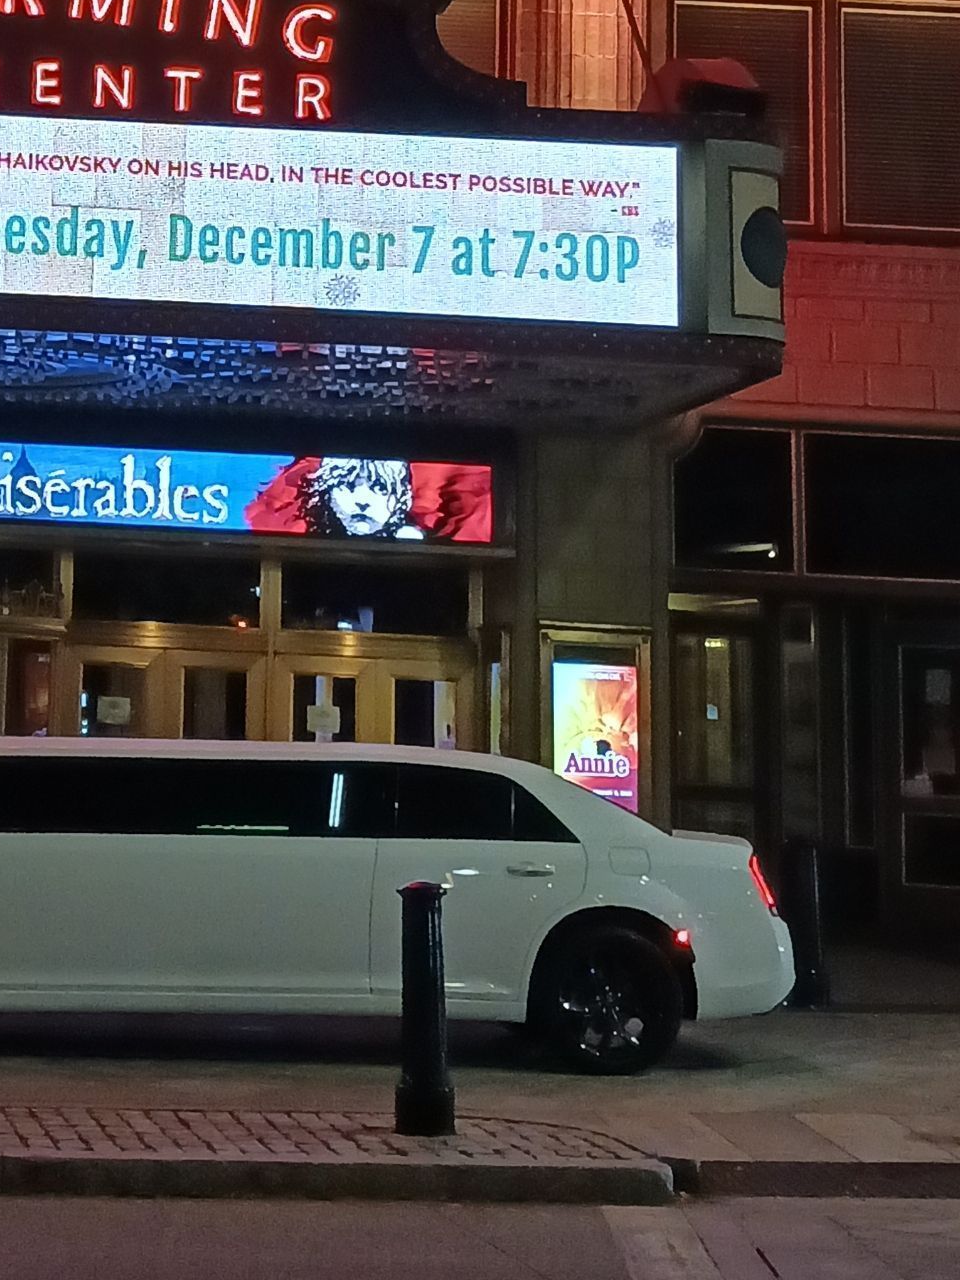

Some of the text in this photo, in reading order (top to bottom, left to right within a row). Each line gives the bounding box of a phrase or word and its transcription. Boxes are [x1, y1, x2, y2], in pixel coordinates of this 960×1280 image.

[127, 157, 160, 176] ON
[167, 160, 203, 179] HIS
[281, 165, 304, 183] IN
[311, 166, 353, 185] THE
[359, 169, 461, 191] COOLEST
[468, 173, 574, 197] POSSIBLE
[168, 213, 396, 272] December
[411, 225, 436, 274] 7
[451, 228, 497, 278] at
[512, 229, 641, 284] 7:30P
[563, 752, 628, 774] Annie
